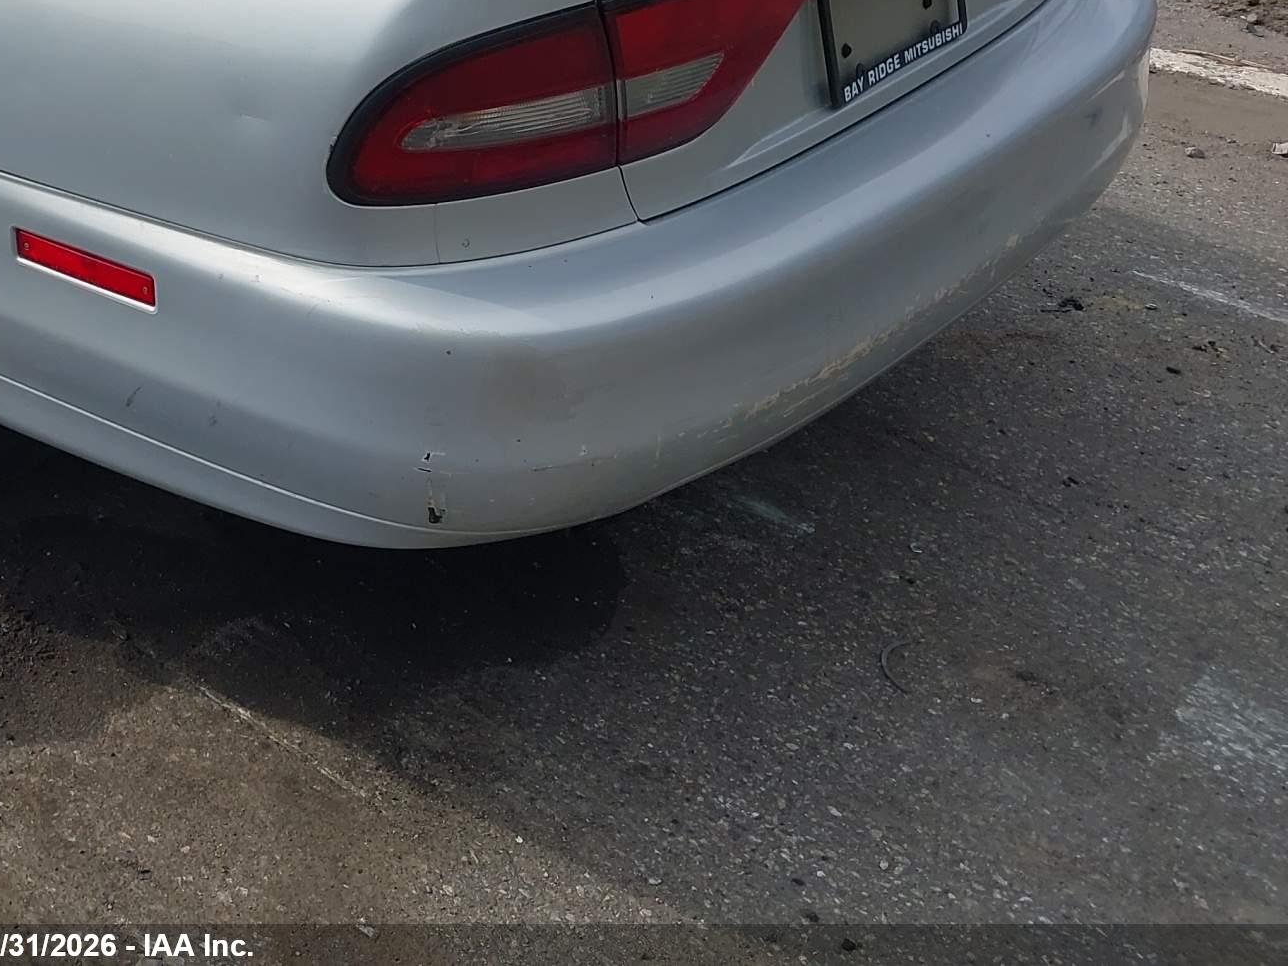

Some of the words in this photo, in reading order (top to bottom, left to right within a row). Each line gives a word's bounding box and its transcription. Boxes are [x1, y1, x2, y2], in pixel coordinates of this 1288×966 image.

[843, 76, 864, 102] BAY
[867, 54, 901, 86] RIDGE
[904, 23, 964, 64] MITSUBISHI
